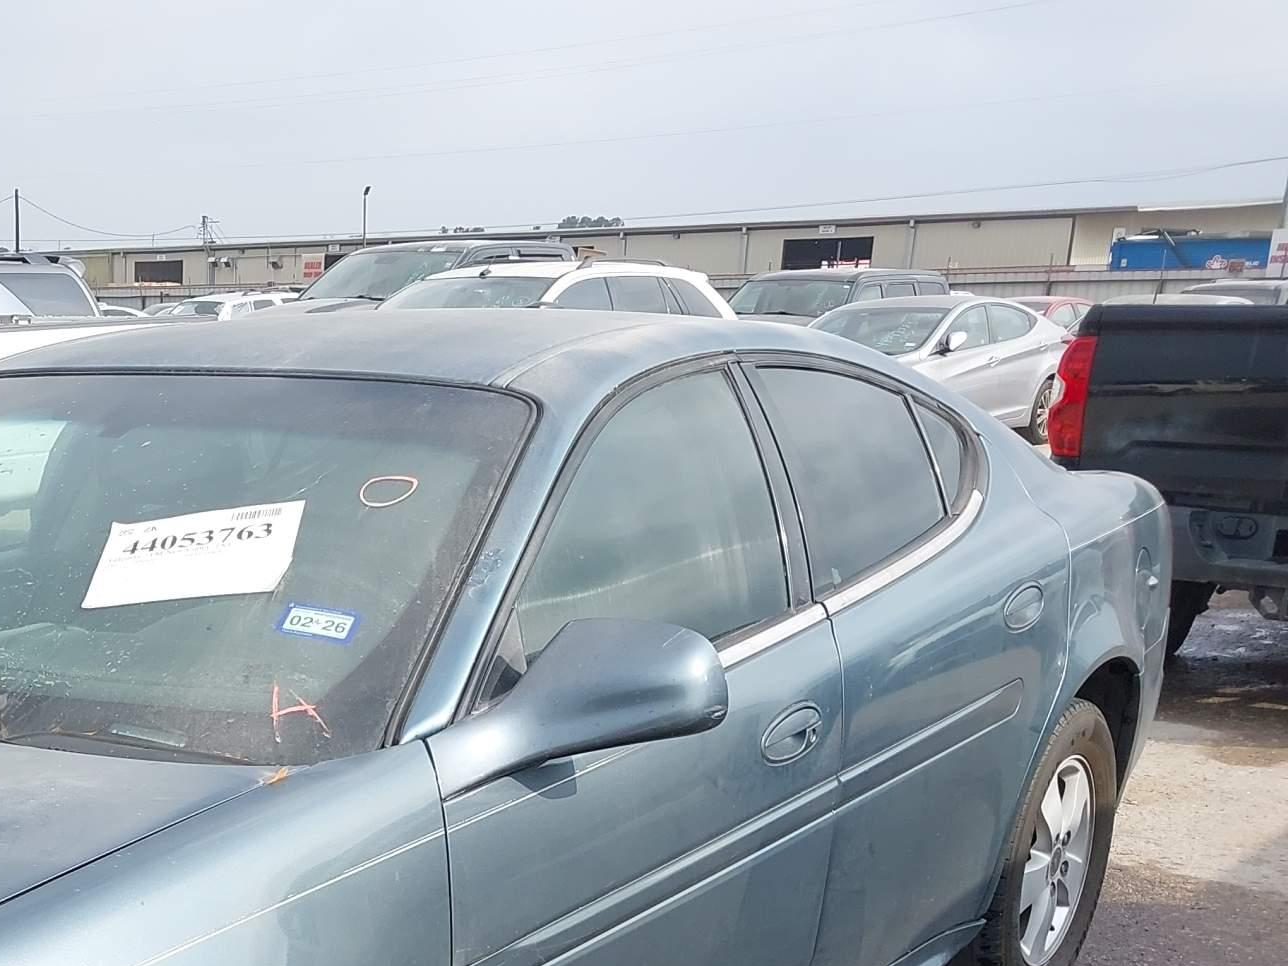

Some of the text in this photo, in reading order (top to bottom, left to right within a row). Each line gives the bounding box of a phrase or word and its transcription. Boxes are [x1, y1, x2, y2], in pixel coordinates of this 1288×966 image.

[122, 522, 273, 555] 44053763
[289, 615, 348, 634] 02 26
